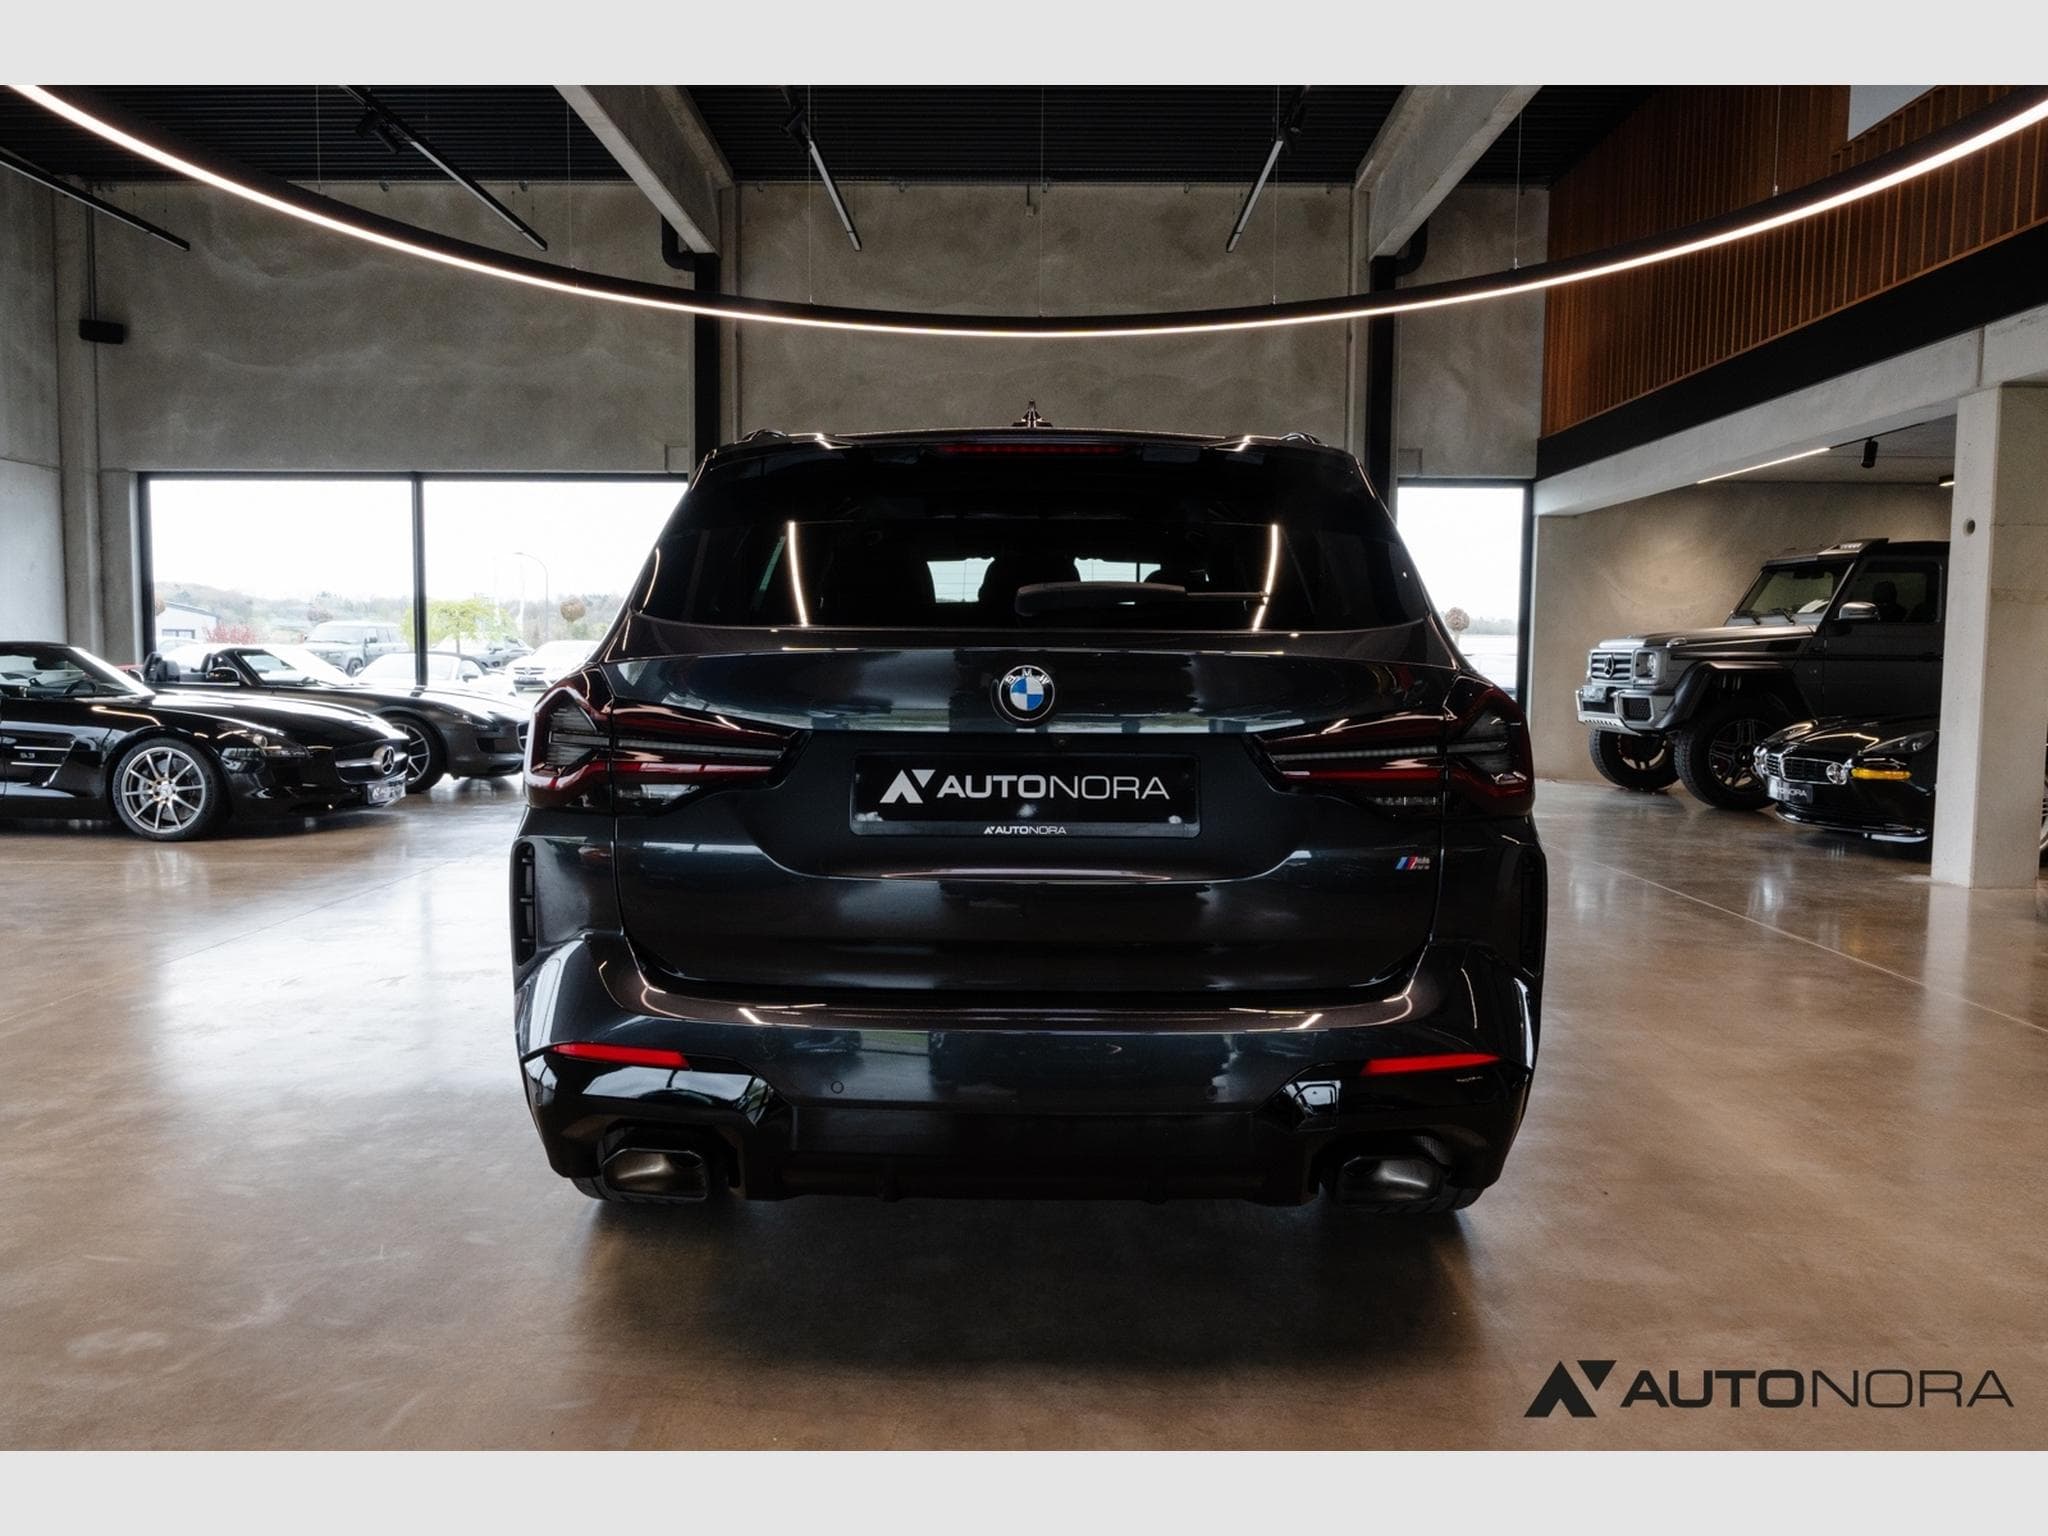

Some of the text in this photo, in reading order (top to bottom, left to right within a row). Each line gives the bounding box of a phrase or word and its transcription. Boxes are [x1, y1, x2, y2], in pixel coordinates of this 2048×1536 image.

[1004, 668, 1051, 685] BMW
[936, 775, 1170, 800] AUTONORA
[994, 825, 1067, 835] AUTONORA
